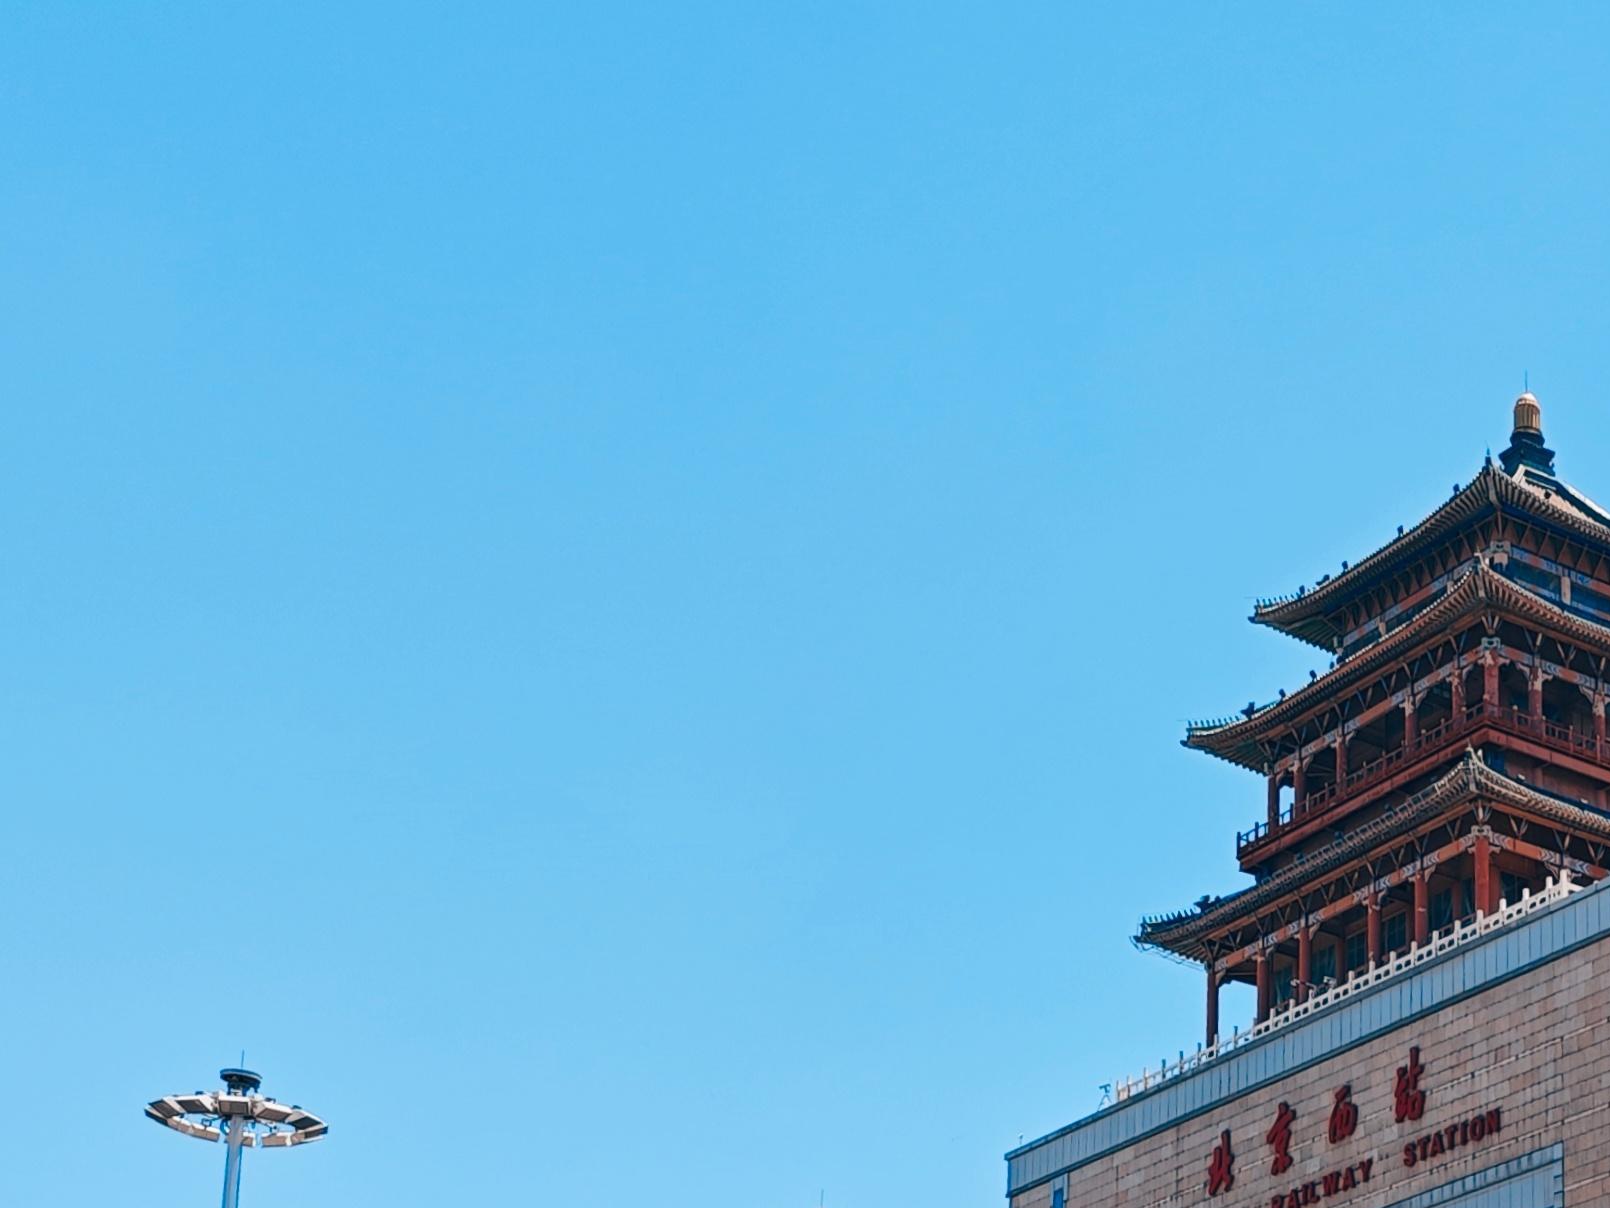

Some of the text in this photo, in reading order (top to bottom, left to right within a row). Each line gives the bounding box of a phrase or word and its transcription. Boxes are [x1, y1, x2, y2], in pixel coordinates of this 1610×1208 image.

[1208, 1046, 1426, 1197] 北京西站
[1403, 1106, 1501, 1168] STATION
